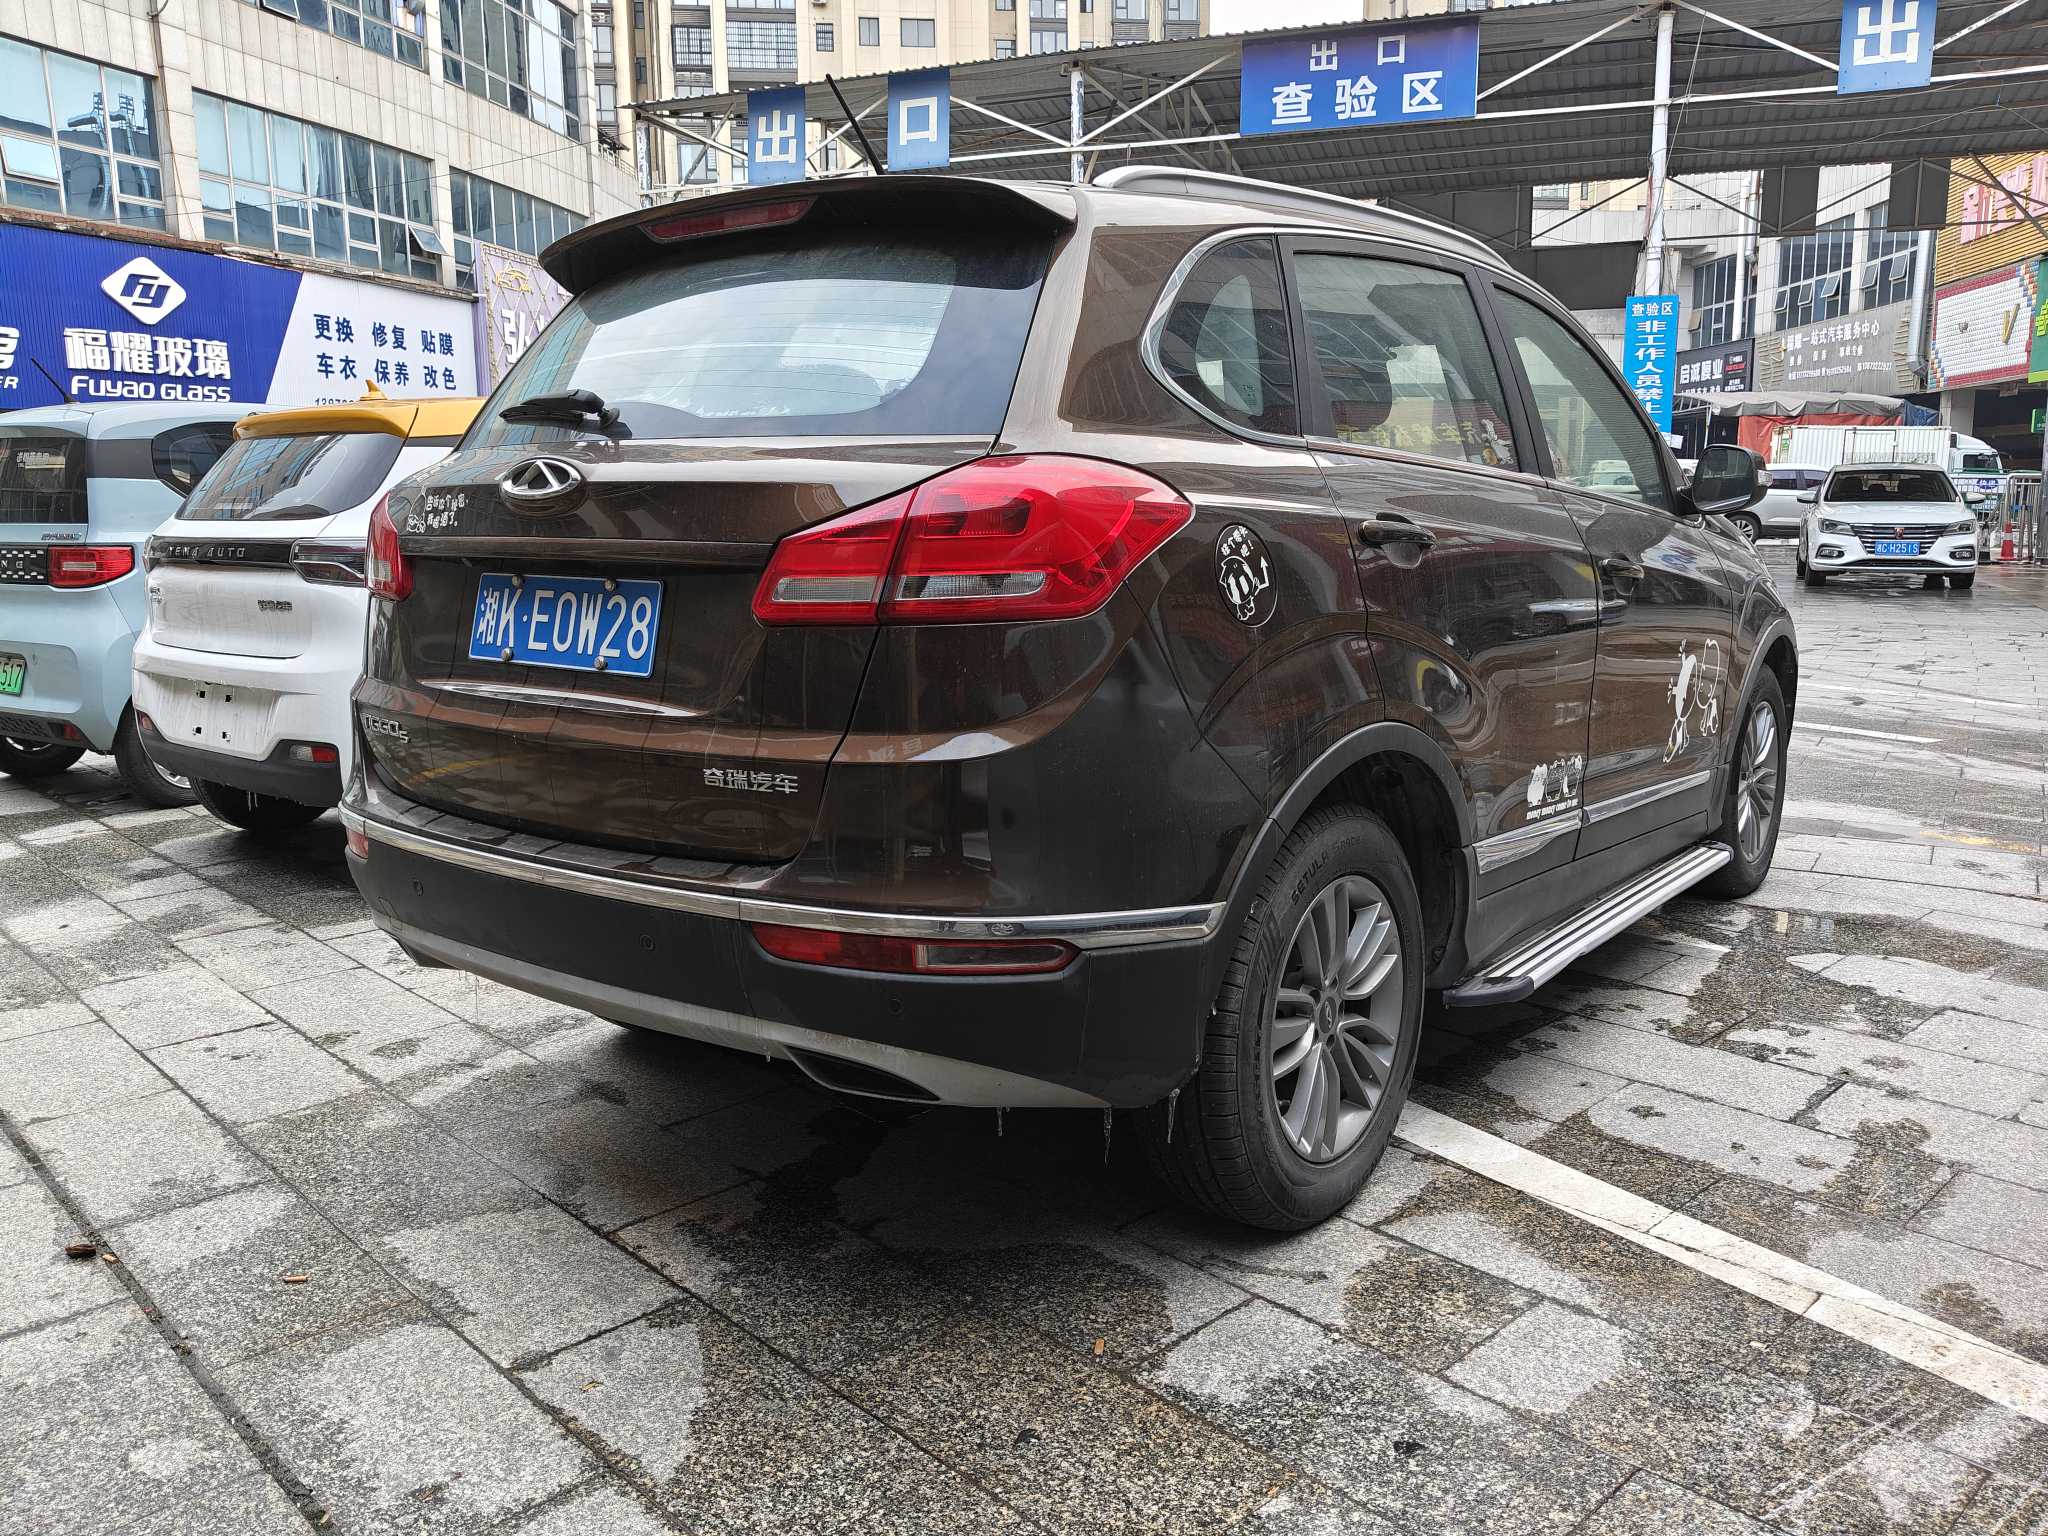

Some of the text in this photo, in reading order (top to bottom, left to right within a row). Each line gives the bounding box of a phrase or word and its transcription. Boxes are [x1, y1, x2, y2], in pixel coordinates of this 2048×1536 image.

[1309, 34, 1406, 72] 出口
[1853, 0, 1920, 66] 出
[1271, 71, 1443, 125] 查验区
[755, 110, 797, 164] 出
[1631, 302, 1673, 316] 查验区
[63, 327, 231, 380] 福耀玻璃
[313, 313, 455, 357] 更换 修复 贴膜
[317, 352, 456, 390] 车衣 保养 改色
[1633, 320, 1668, 428] 非工作人员禁止
[703, 768, 798, 793] 奇瑞汽车
